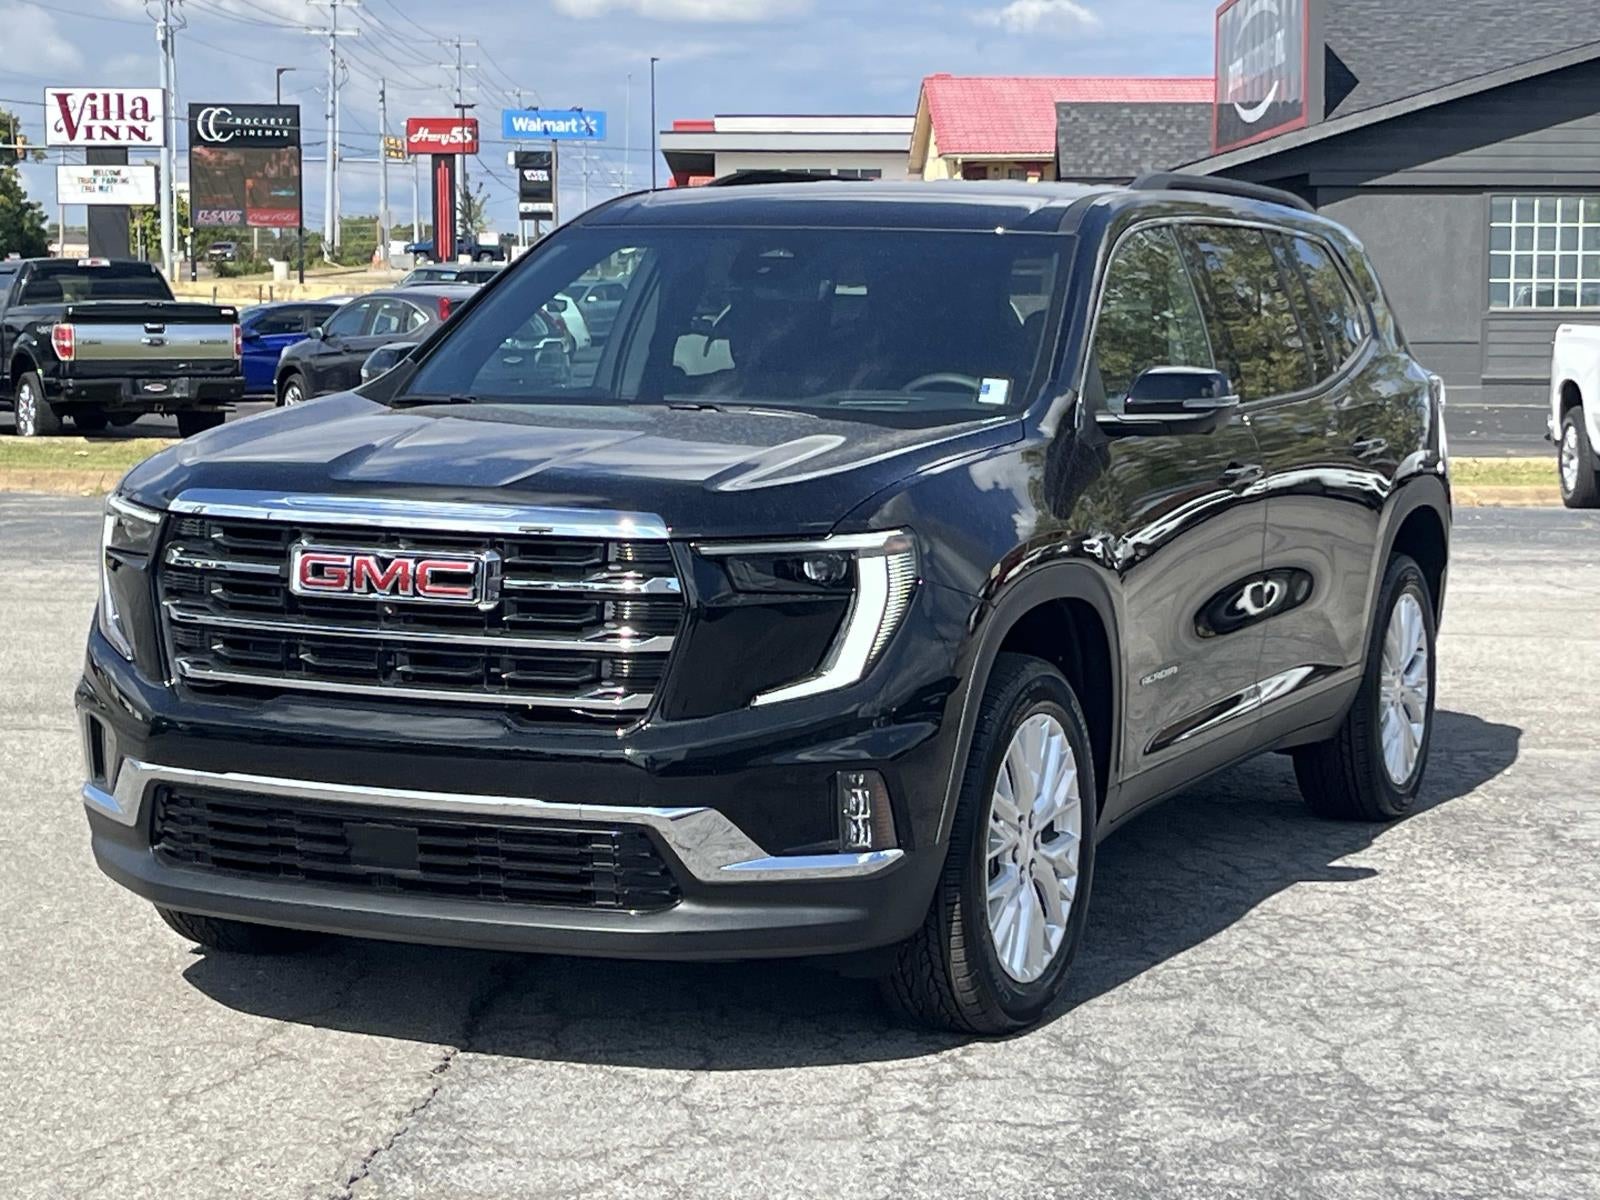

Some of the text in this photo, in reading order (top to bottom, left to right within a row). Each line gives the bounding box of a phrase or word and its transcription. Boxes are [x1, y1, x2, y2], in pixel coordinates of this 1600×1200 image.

[51, 92, 155, 142] Villa
[227, 117, 292, 126] CROCKETT
[512, 116, 578, 133] Walmart
[83, 125, 152, 142] INN
[235, 129, 289, 137] CINEMAS
[300, 552, 477, 600] GMC
